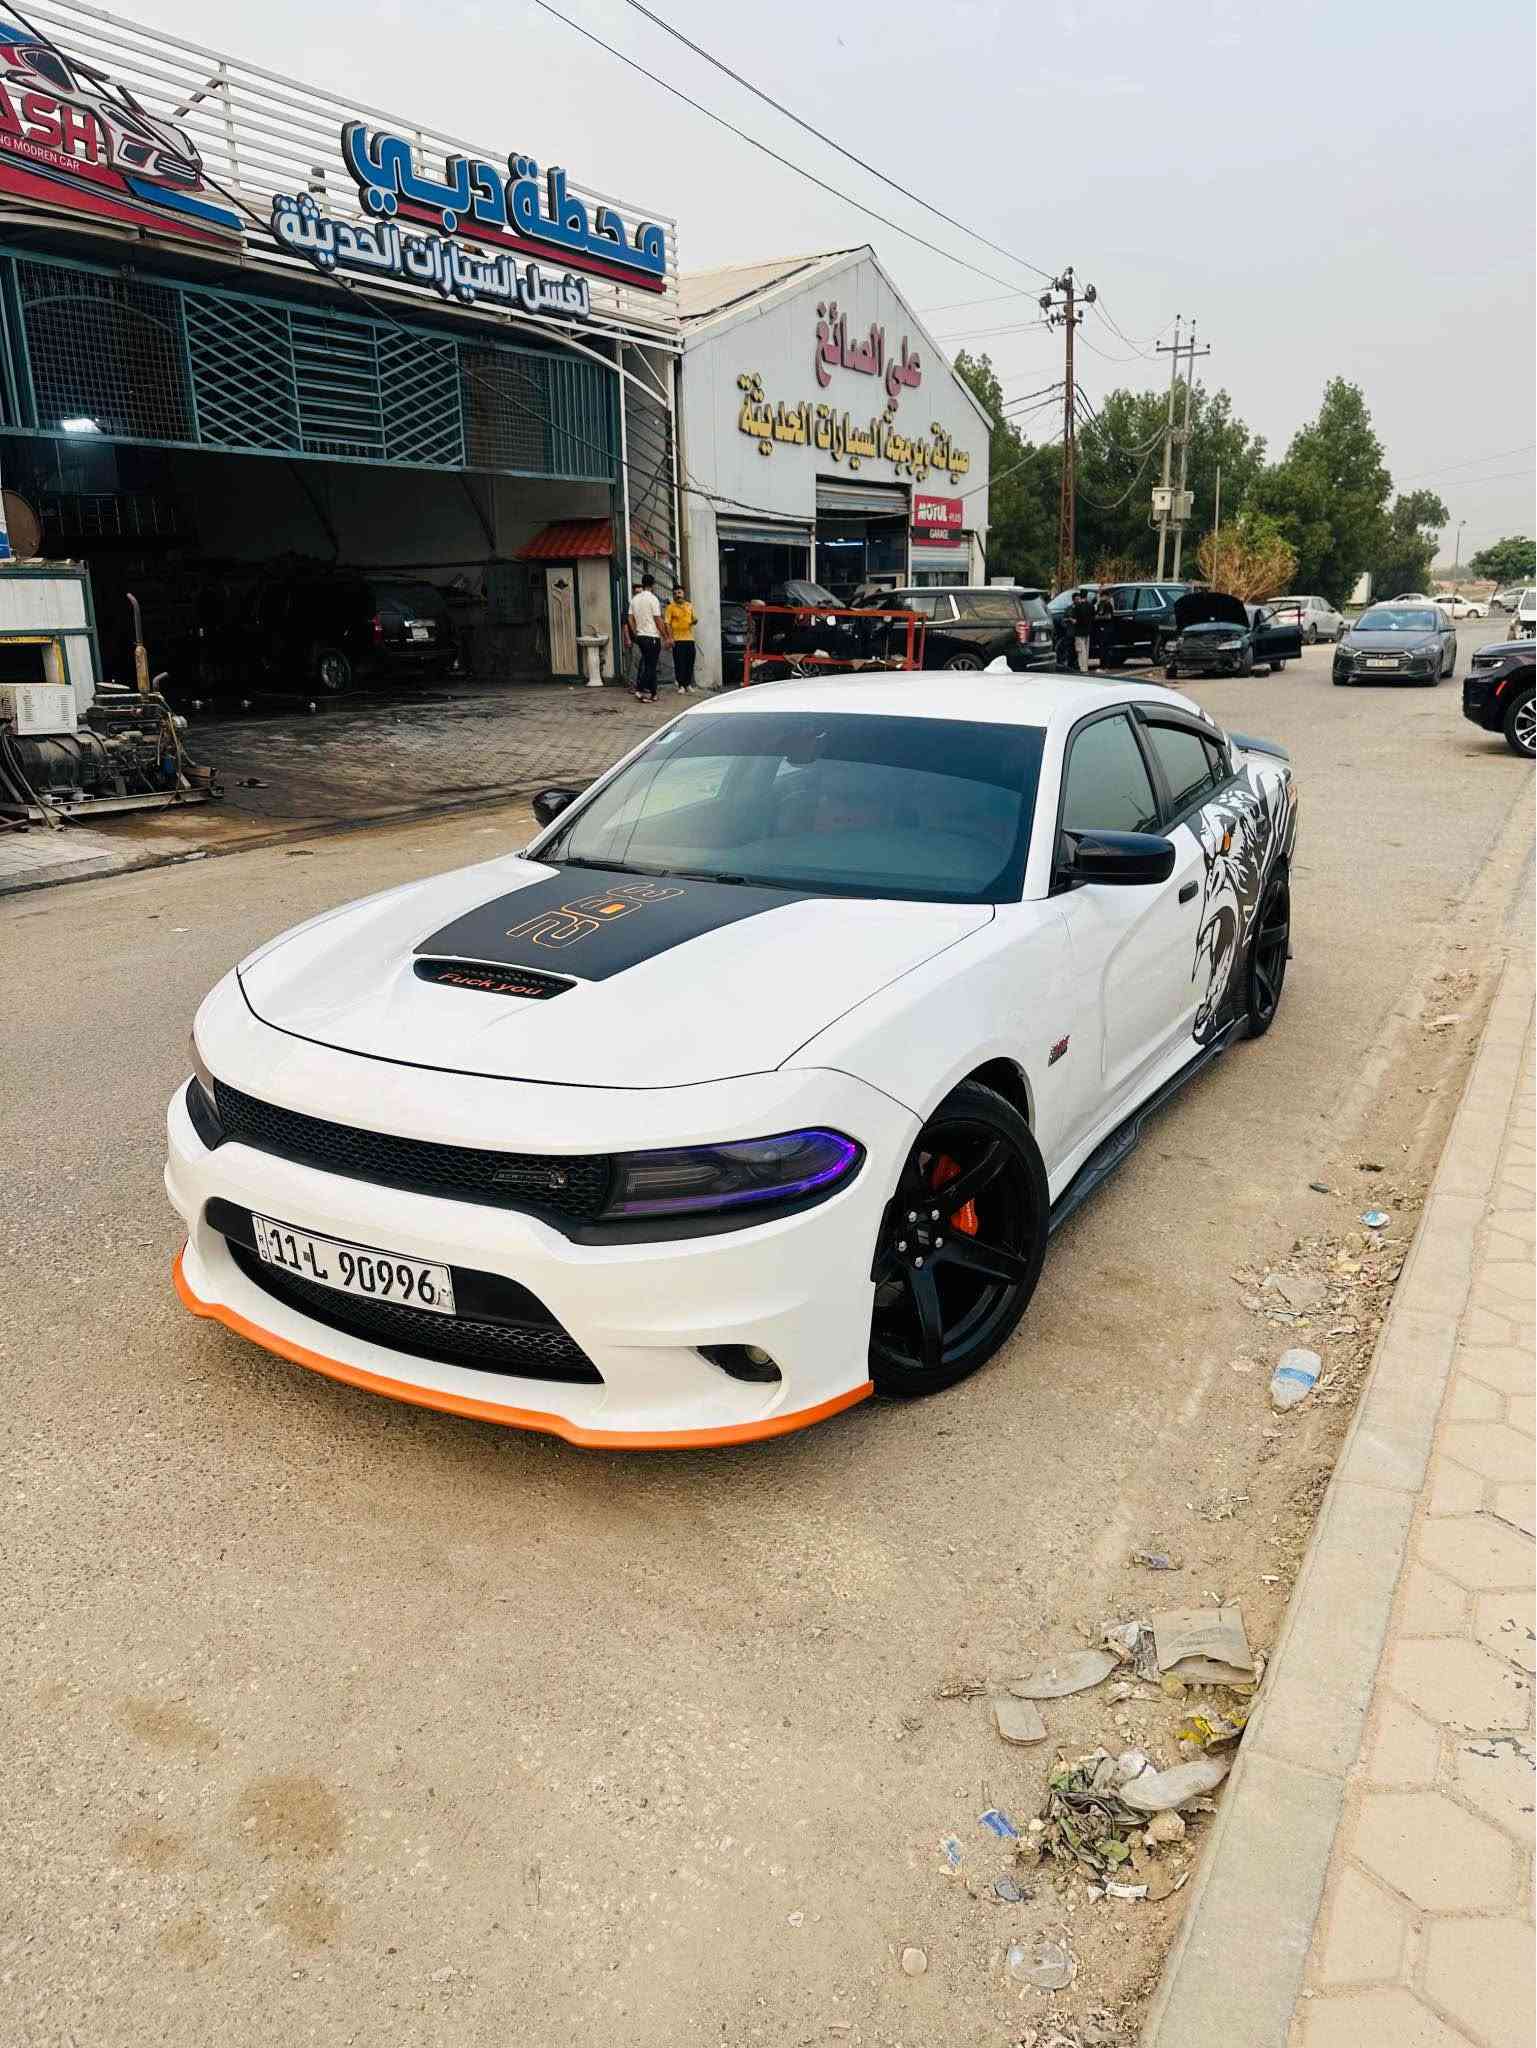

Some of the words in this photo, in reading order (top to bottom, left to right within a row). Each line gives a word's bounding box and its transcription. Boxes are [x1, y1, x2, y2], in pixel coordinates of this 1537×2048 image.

[13, 138, 57, 162] MODREN
[60, 155, 80, 171] CAR
[342, 120, 506, 236] دبي
[271, 192, 402, 272] الحديثة
[508, 153, 667, 275] محطة
[402, 234, 518, 304] السيارات
[516, 264, 591, 317] لغسل
[815, 301, 885, 388] الصائغ
[885, 335, 922, 413] علي
[737, 372, 813, 456] الحديثة
[815, 404, 883, 471] السيارات
[930, 422, 970, 485] صيانة
[917, 502, 948, 522] MOTUL
[437, 972, 495, 988] Fuck
[492, 982, 544, 995] you
[338, 1250, 435, 1305] 90996
